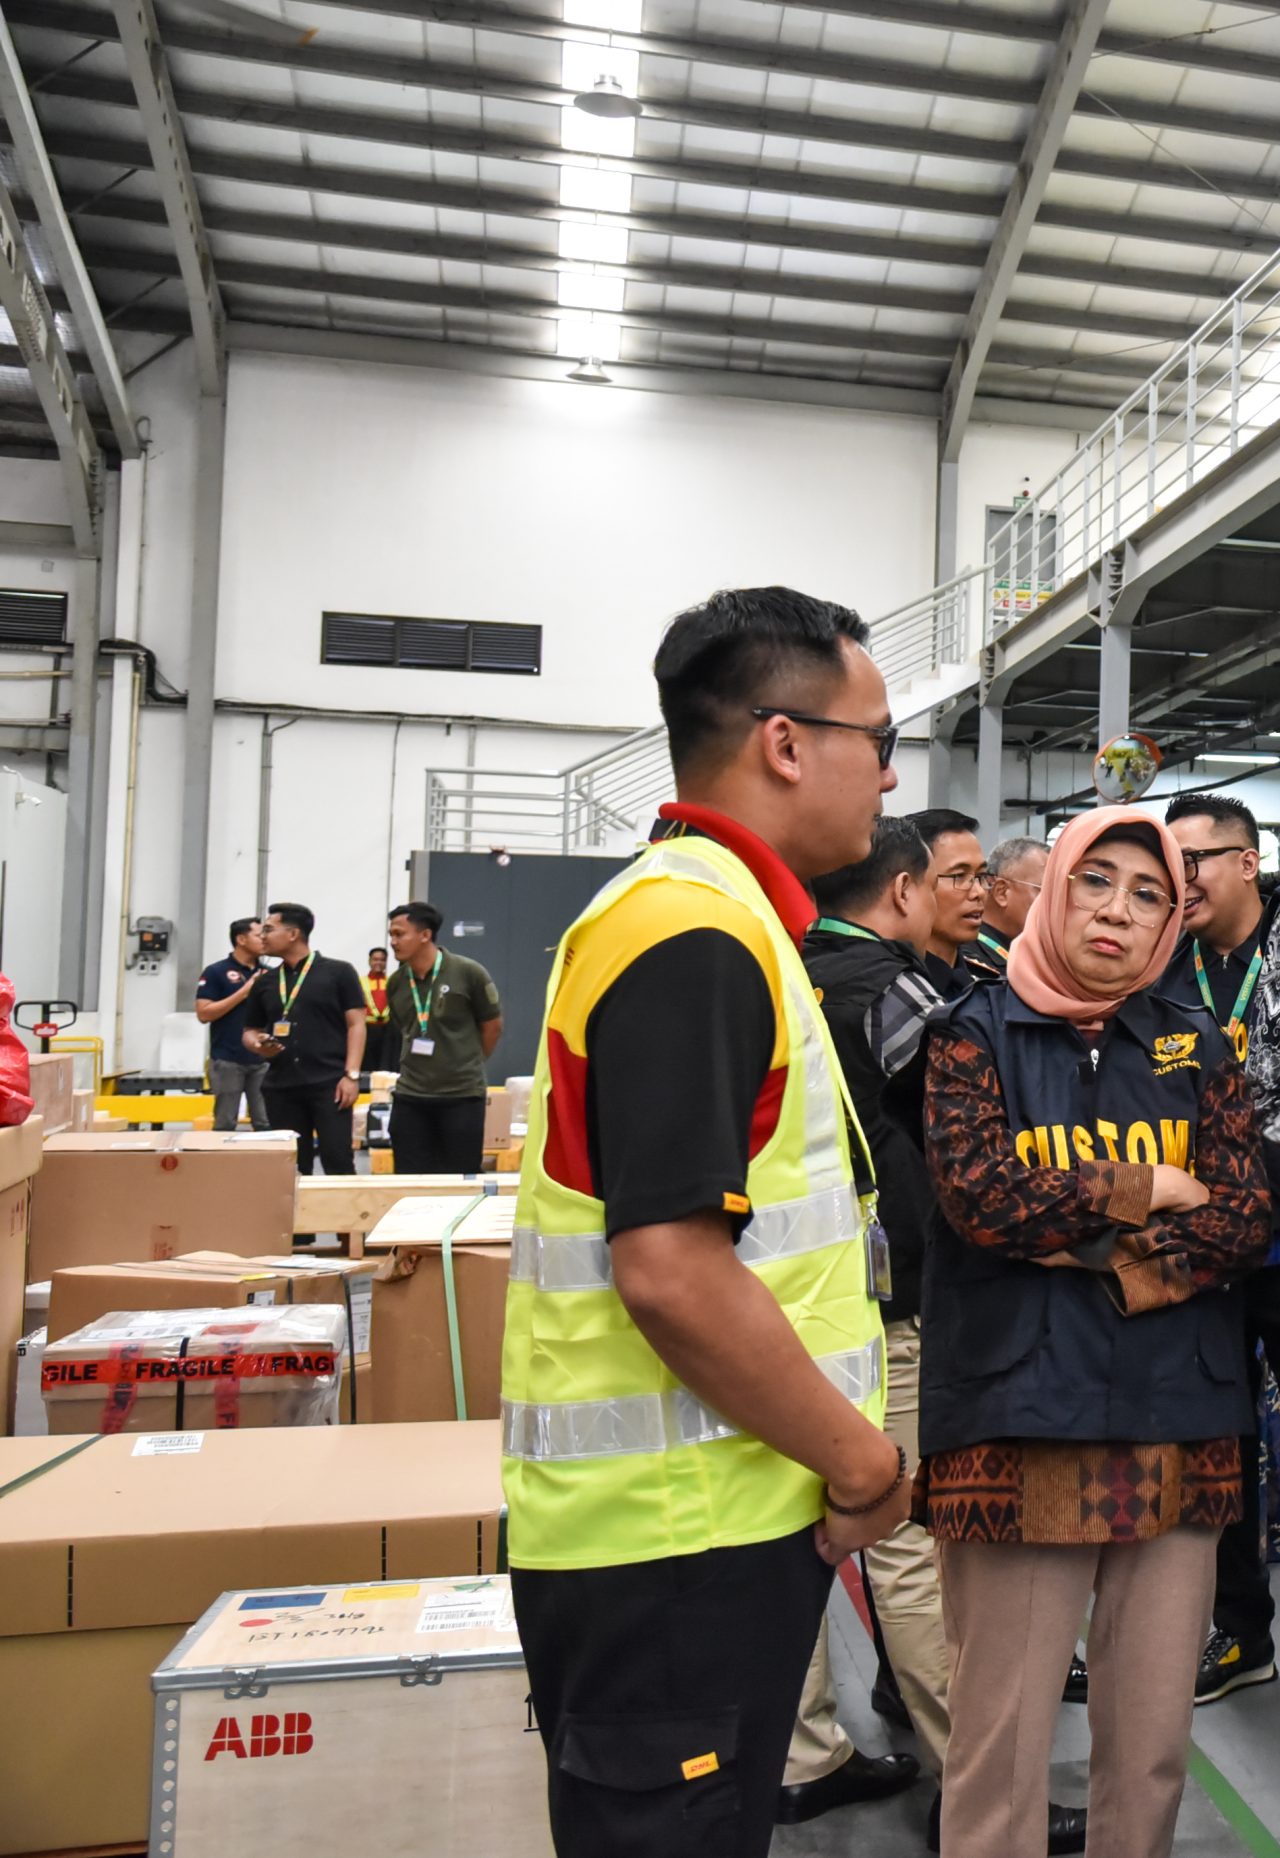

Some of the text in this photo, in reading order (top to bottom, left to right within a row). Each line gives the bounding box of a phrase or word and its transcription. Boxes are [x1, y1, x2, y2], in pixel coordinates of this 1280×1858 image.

[1015, 1118, 1196, 1178] CUSTOM
[136, 1357, 234, 1379] FRAGILE
[204, 1712, 314, 1761] ABB
